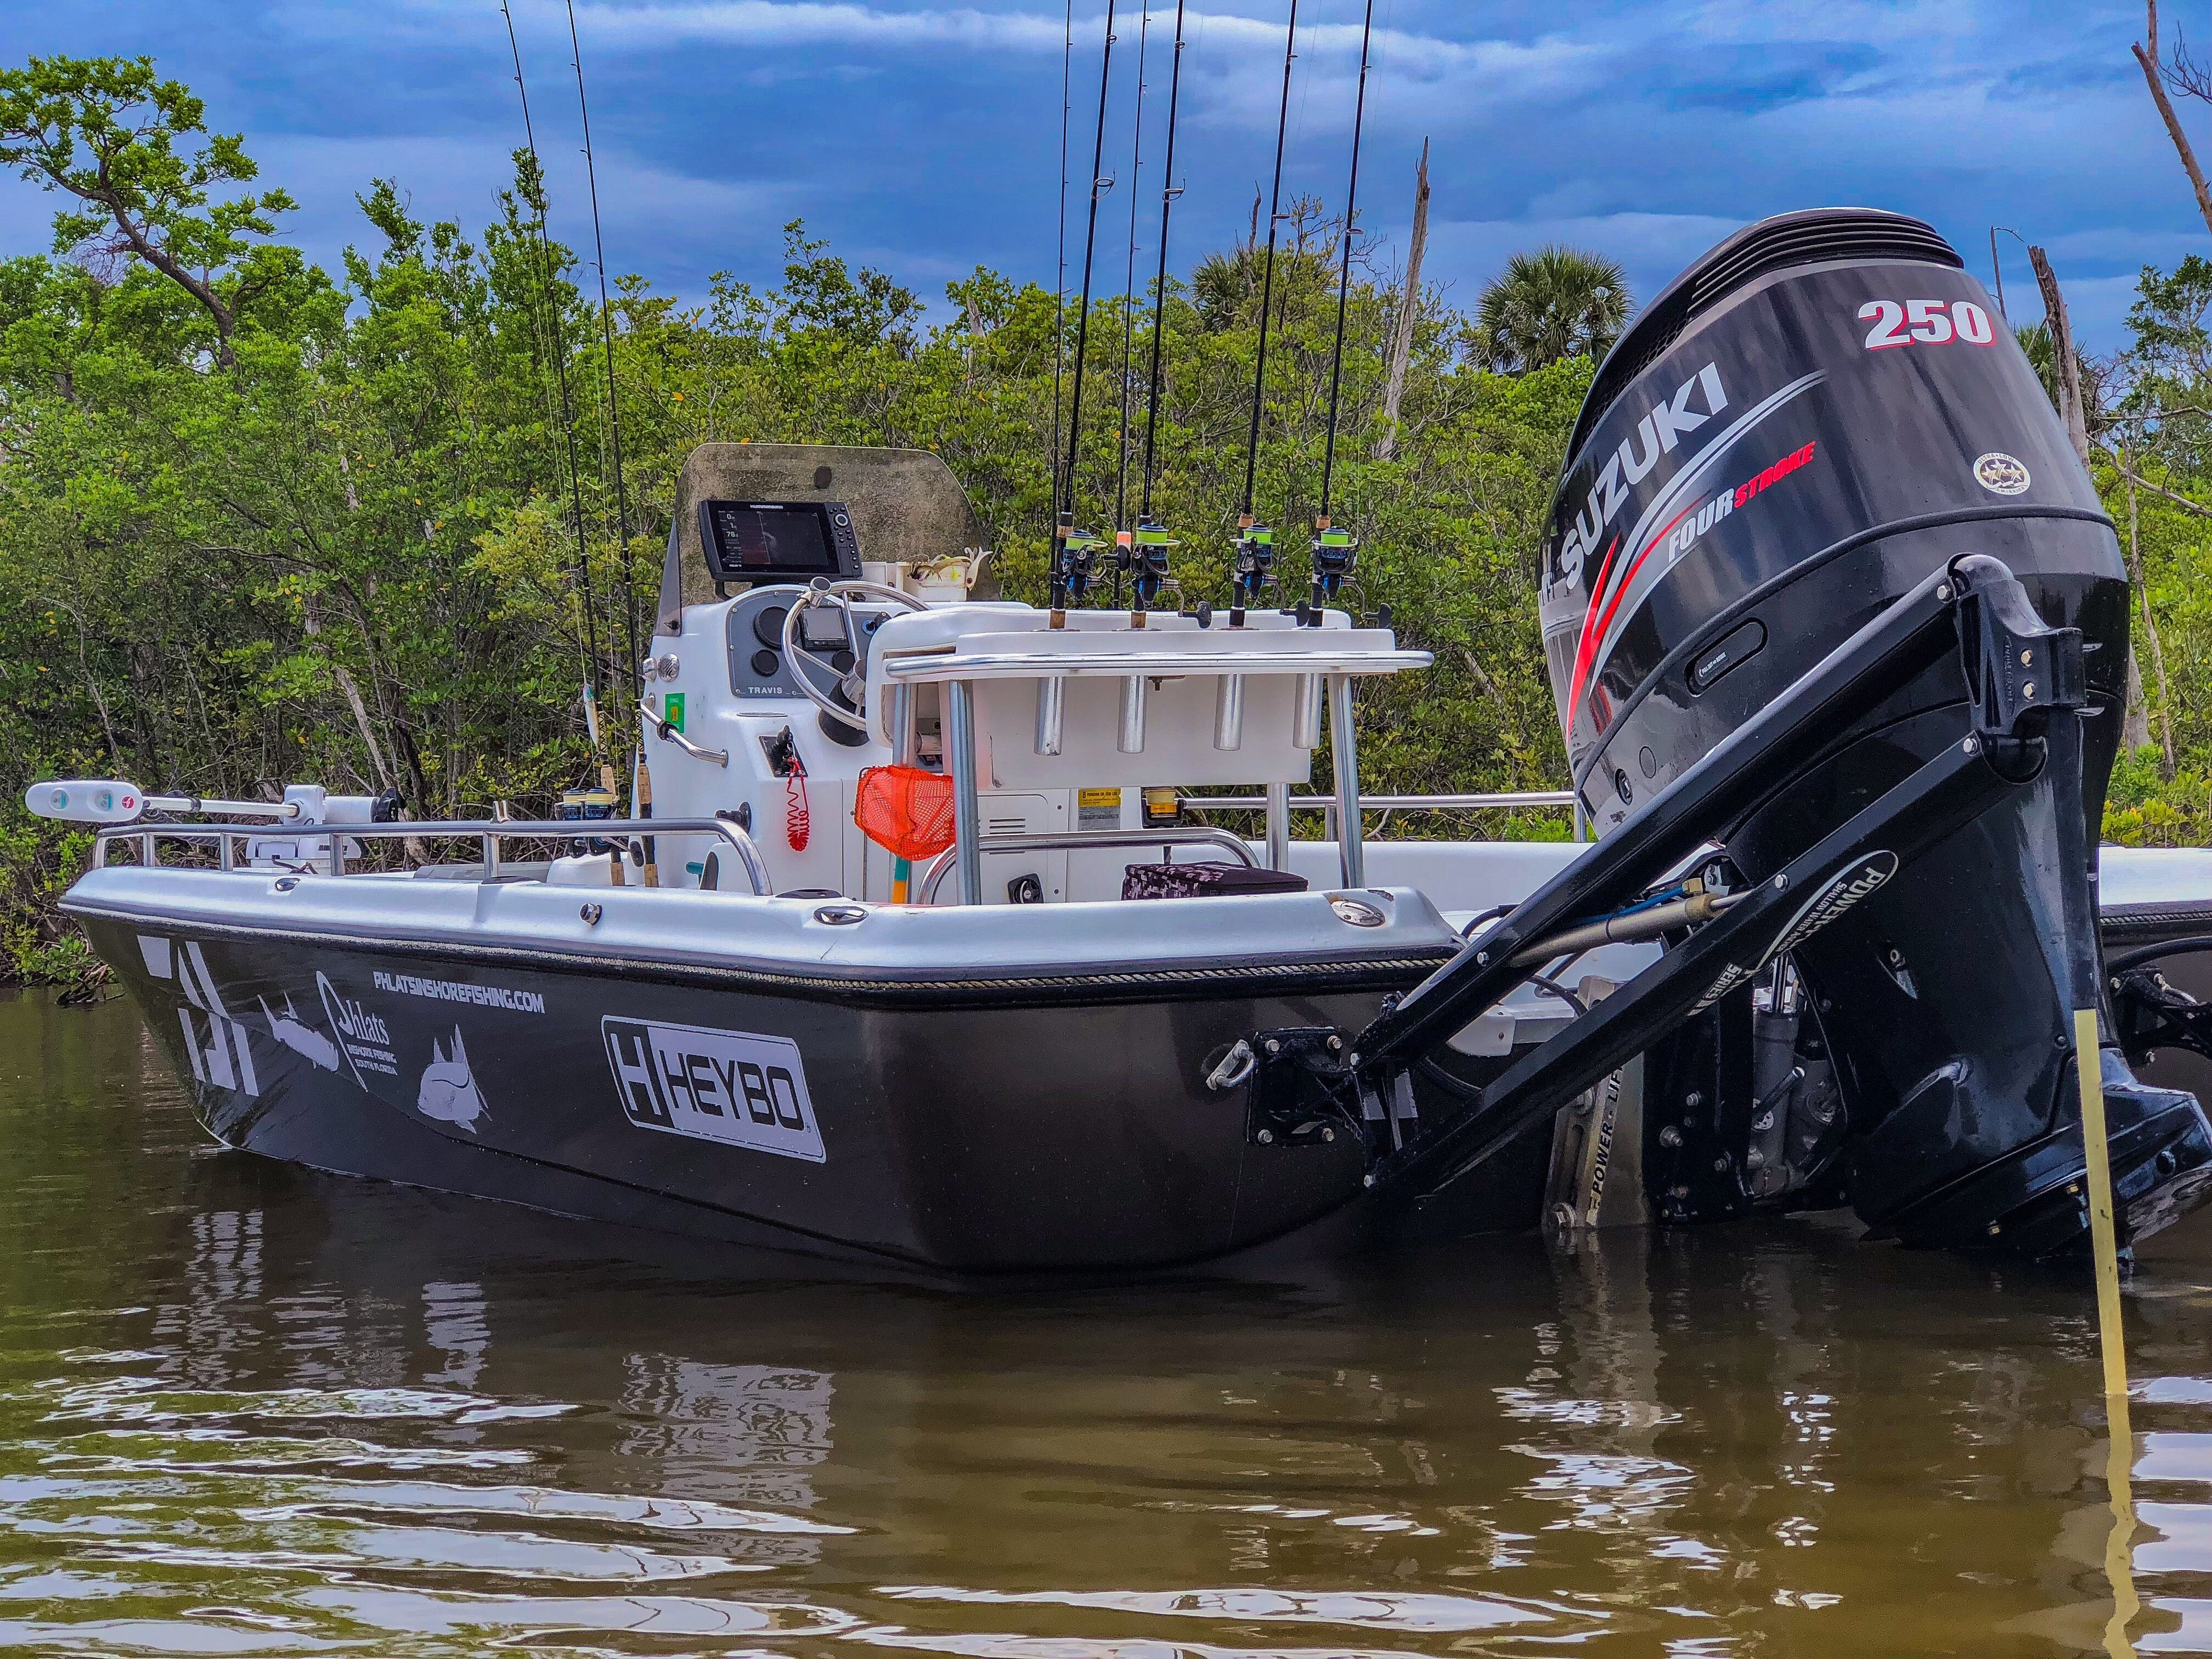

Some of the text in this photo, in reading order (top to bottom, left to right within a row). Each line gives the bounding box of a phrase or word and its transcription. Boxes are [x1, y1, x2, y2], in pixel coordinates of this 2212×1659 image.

[1858, 300, 1996, 350] 250
[1561, 361, 1729, 590] SUZUKI
[1816, 881, 1847, 912] SHALLOW
[1797, 912, 1821, 932] WATER
[373, 971, 545, 1014] PHLATSINSHOREFISHING.COM
[1705, 964, 1742, 999] SERIES
[659, 1049, 805, 1131] HEYBO
[1592, 1121, 1613, 1195] POWER
